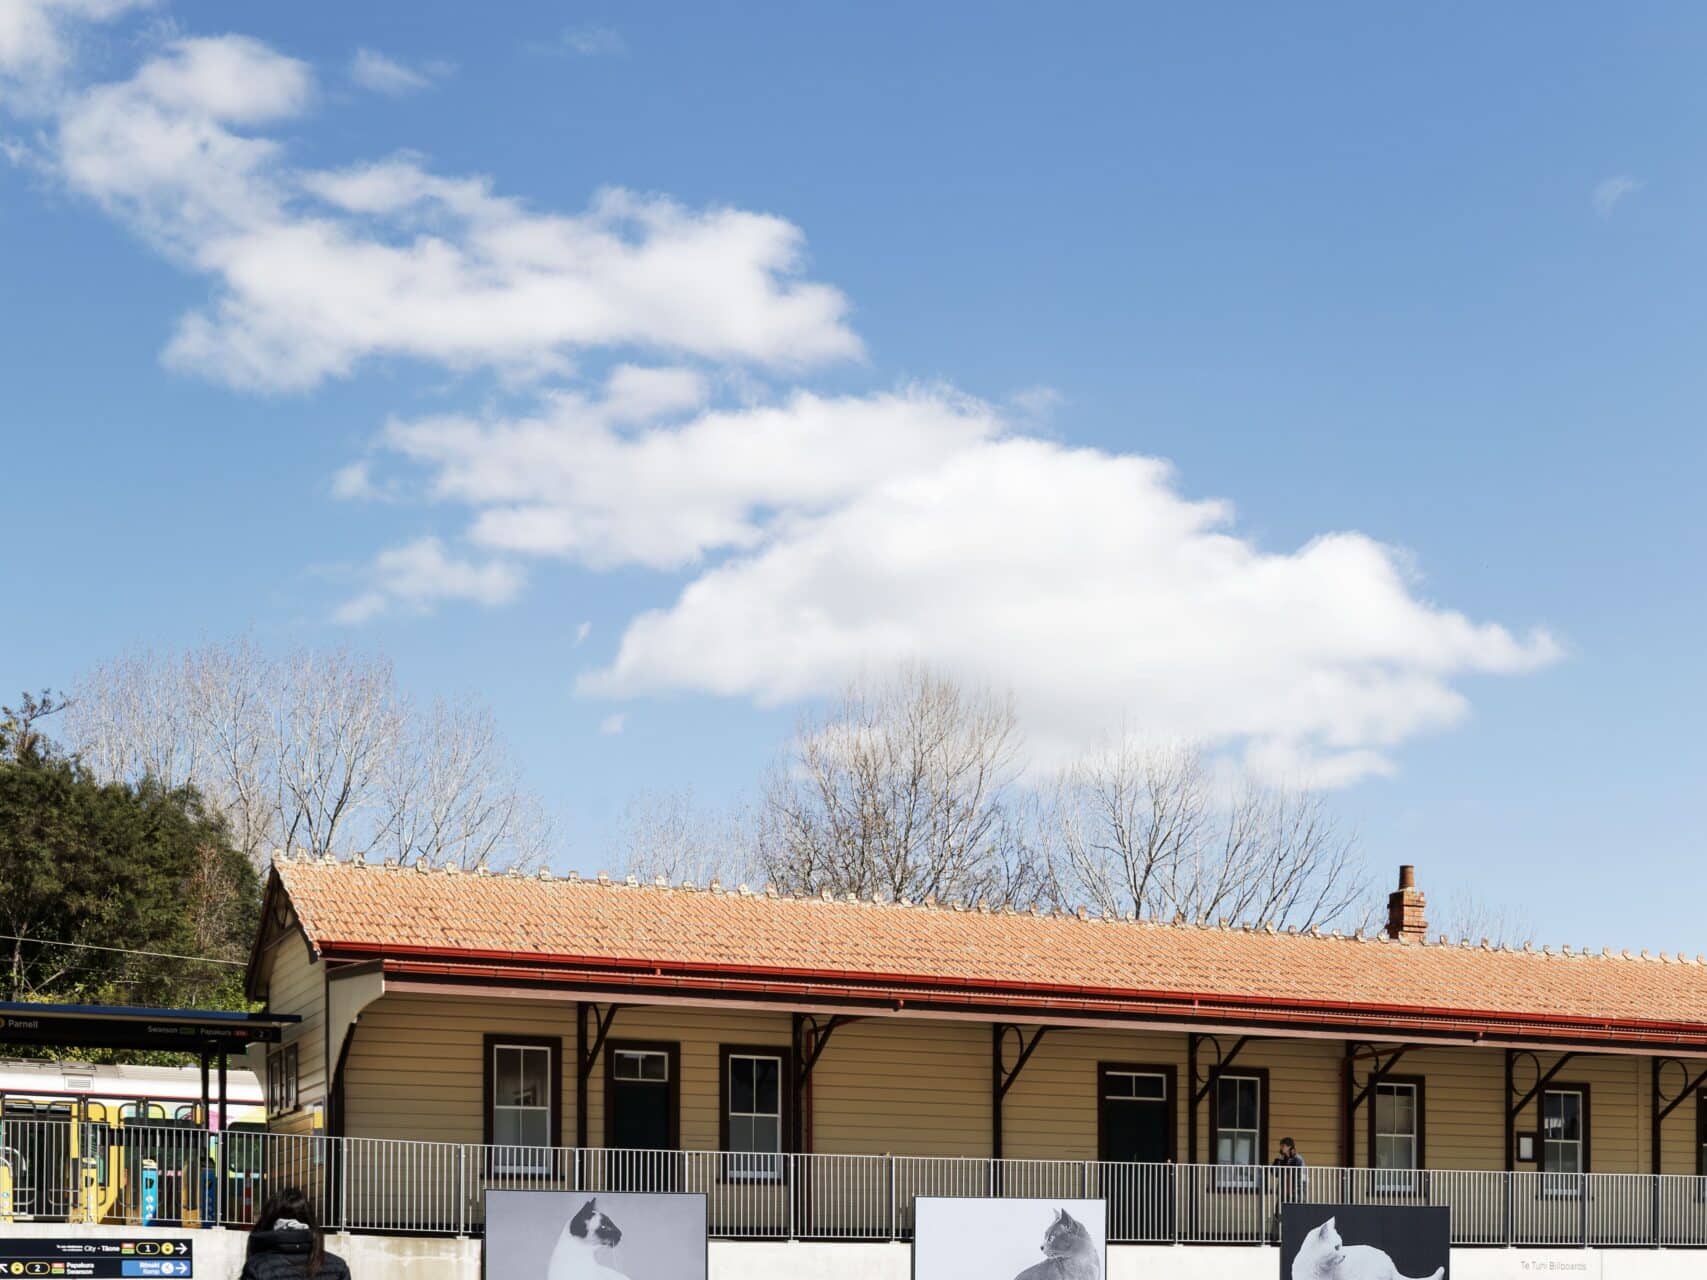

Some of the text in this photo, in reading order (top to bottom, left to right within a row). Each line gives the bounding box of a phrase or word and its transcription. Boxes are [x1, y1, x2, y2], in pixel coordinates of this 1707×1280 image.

[8, 1018, 39, 1029] Parnell
[83, 1245, 97, 1253] City
[34, 1264, 41, 1272] 2
[1520, 1260, 1530, 1271] Te
[1549, 1261, 1587, 1271] Billboards
